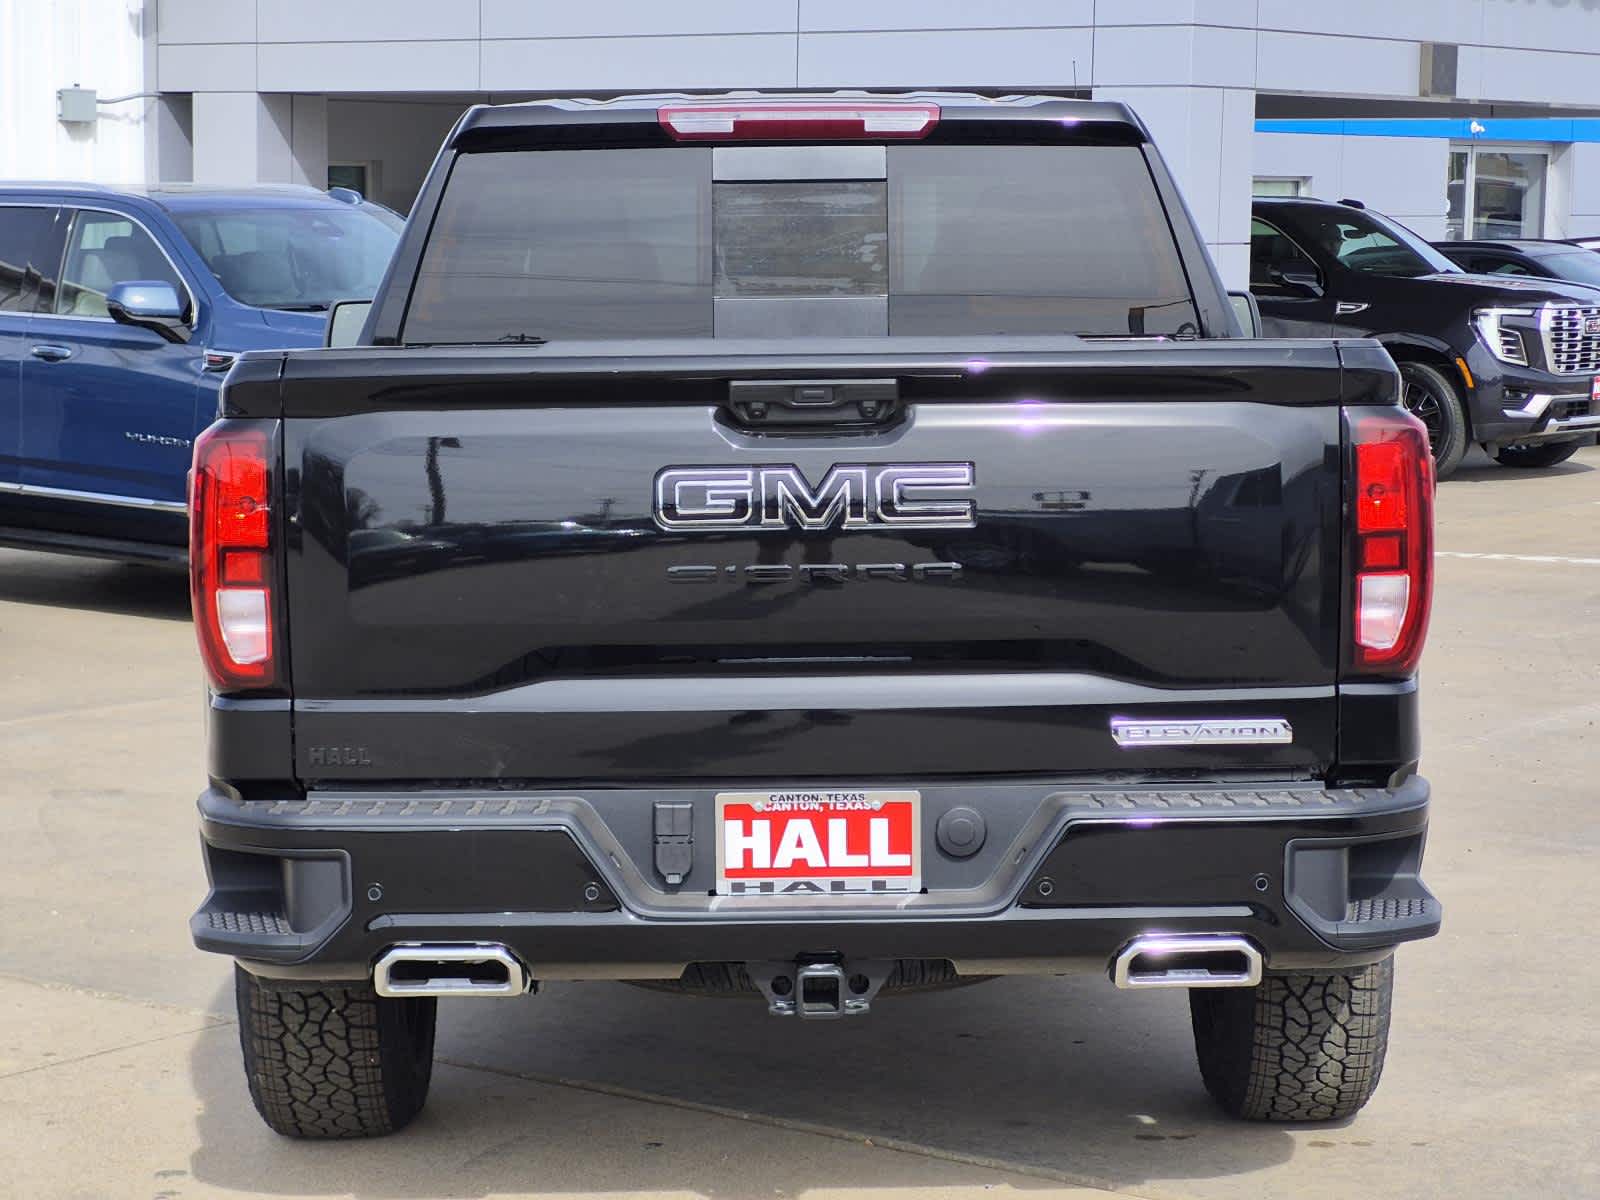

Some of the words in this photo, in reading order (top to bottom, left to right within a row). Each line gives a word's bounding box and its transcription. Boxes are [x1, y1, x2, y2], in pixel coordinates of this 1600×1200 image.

[652, 462, 977, 531] GMC
[667, 561, 963, 584] SIERRA
[1124, 725, 1279, 739] ELEVATION
[308, 746, 372, 766] HALL
[826, 793, 865, 802] TEXAS
[827, 800, 872, 811] TEXAS
[724, 817, 912, 869] HALL
[730, 879, 908, 893] HALL
